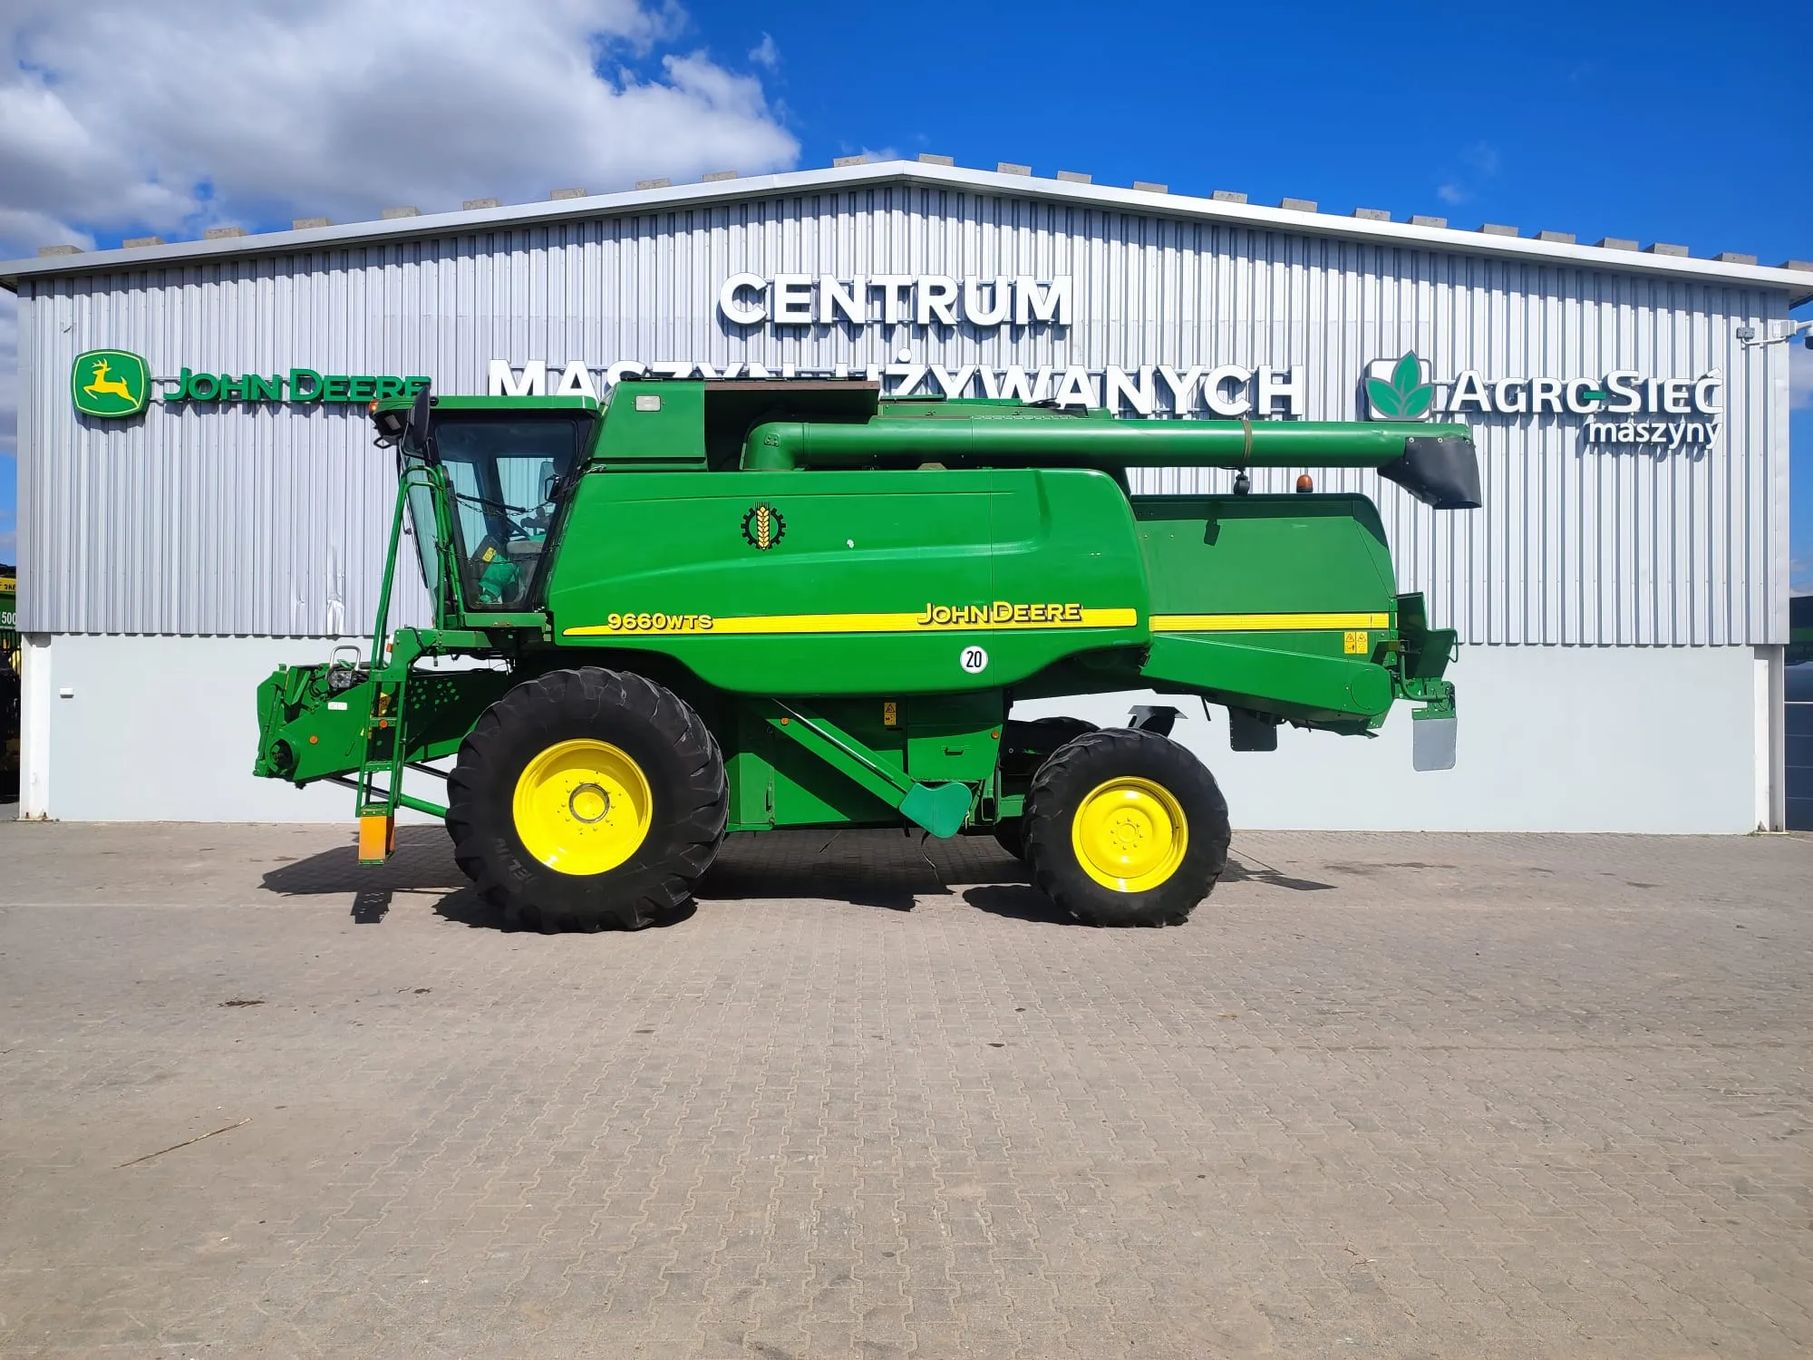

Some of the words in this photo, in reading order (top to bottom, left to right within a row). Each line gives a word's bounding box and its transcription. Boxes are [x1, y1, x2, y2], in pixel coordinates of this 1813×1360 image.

[719, 272, 1073, 326] CENTRUM
[163, 367, 282, 402] JOHN
[835, 347, 1304, 416] ŻYWANYCH
[1588, 422, 1723, 450] maszyny
[607, 612, 713, 630] 9660WTS
[918, 602, 991, 624] JOHN
[992, 601, 1083, 623] DEERE
[966, 650, 982, 668] 20
